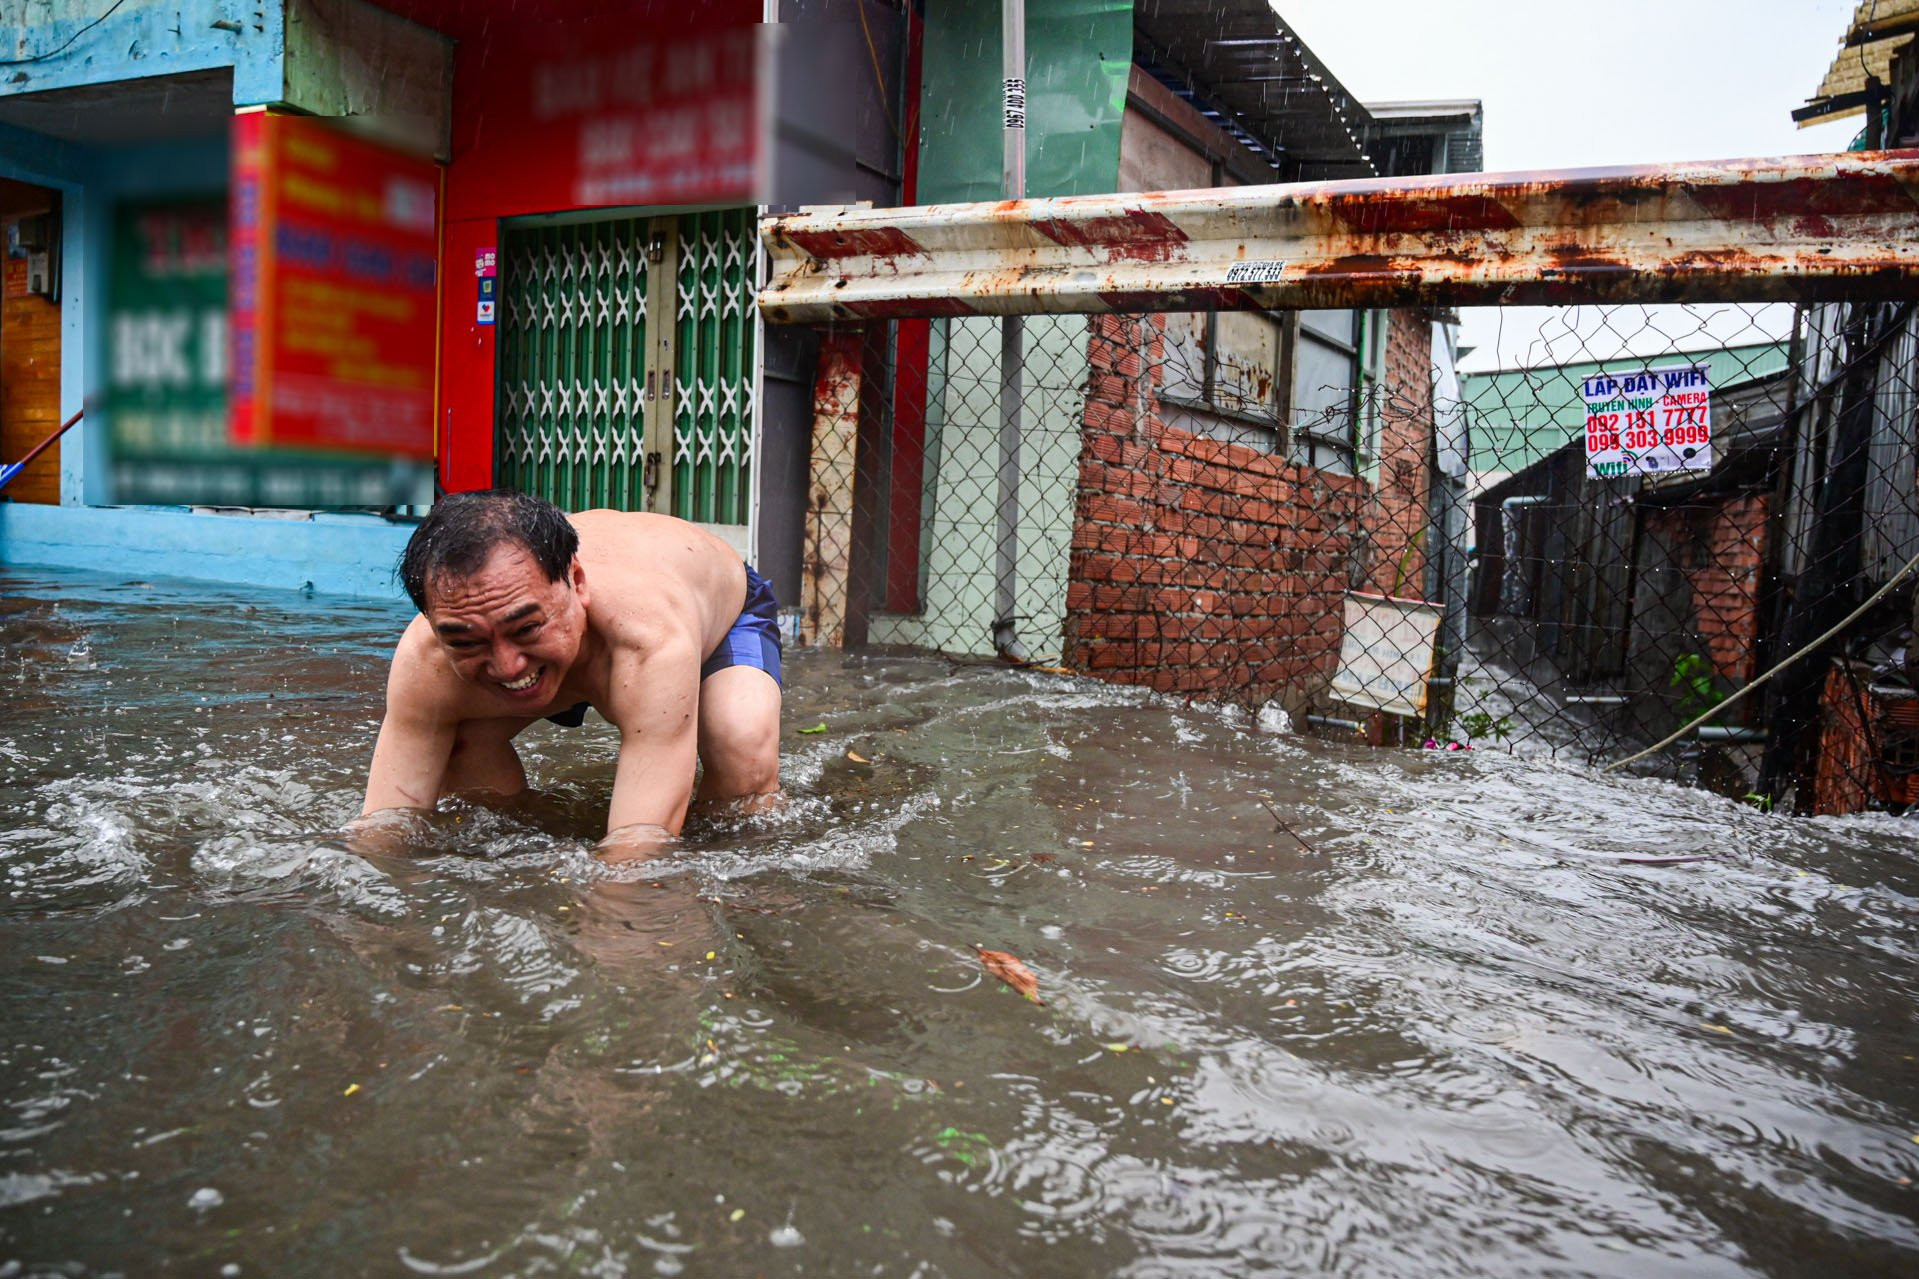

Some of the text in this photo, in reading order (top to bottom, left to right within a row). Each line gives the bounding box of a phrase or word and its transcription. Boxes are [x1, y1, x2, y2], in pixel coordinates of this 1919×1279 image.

[1664, 370, 1706, 388] WIFI
[1664, 392, 1707, 406] CAMERA
[1587, 406, 1708, 433] 092 151 7777
[1588, 425, 1709, 452] 099 303 9999
